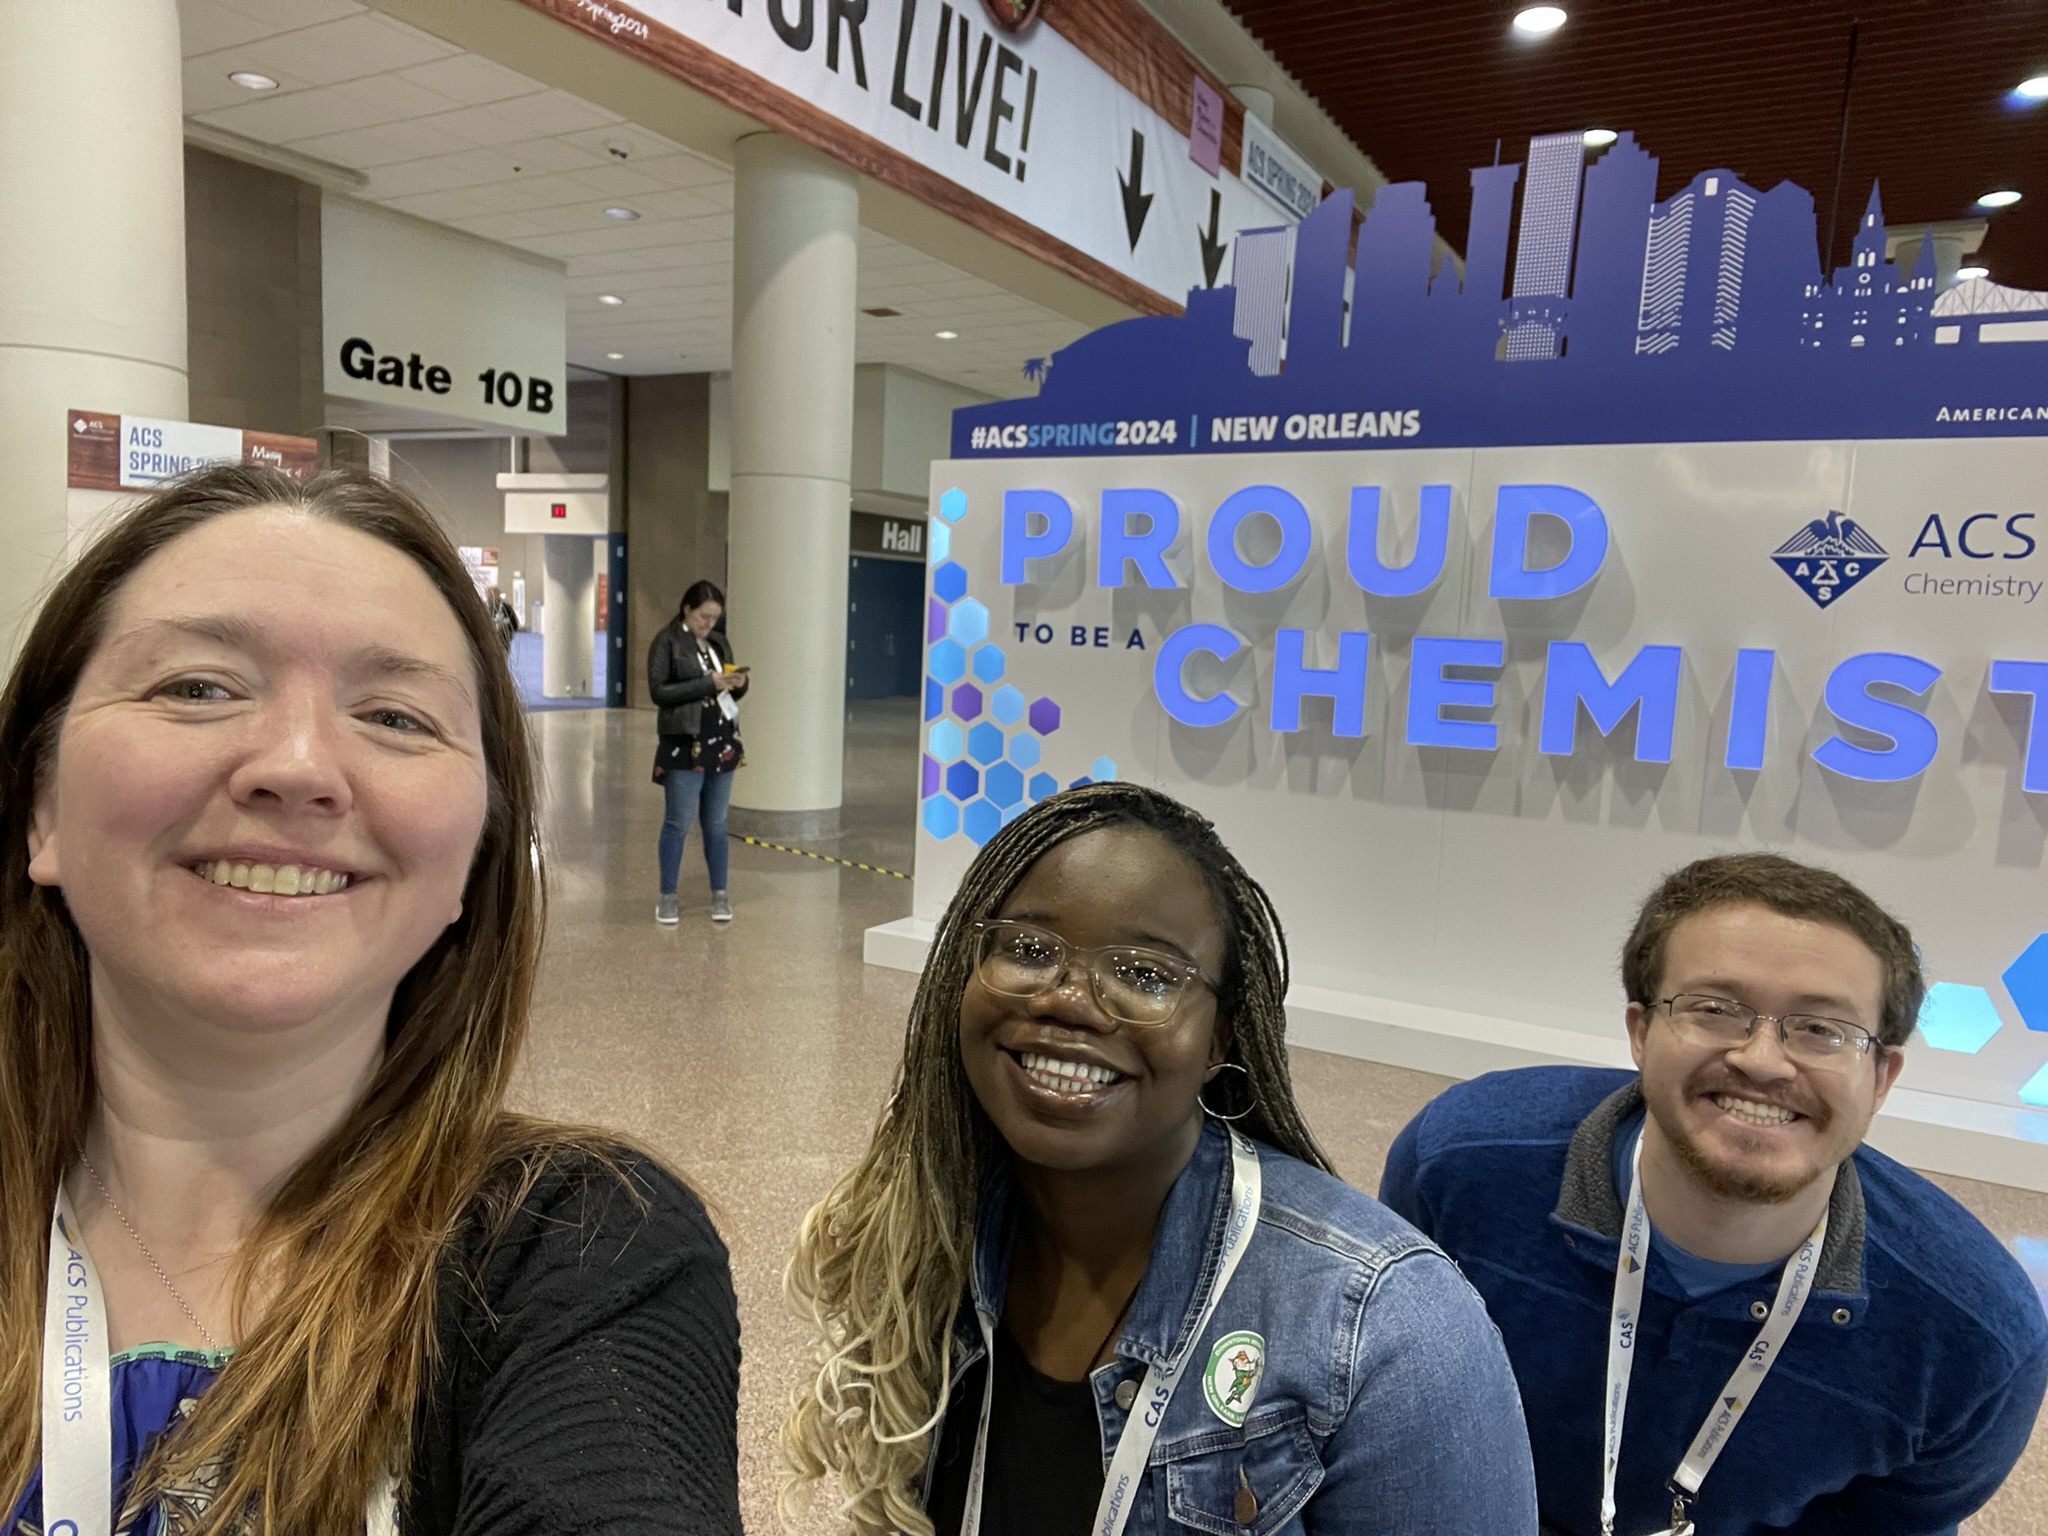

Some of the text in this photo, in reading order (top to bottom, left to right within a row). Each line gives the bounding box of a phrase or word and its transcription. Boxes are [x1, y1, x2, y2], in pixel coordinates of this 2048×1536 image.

[891, 0, 1037, 183] LIVE!
[340, 337, 554, 414] Gate 10B
[129, 426, 163, 448] ACS
[971, 410, 1421, 450] #ACSSPRING2024 NEW ORLEANS
[129, 451, 192, 474] SPRING
[882, 521, 922, 553] Hall
[1000, 484, 1609, 599] PROUD
[1908, 513, 2037, 560] ACS
[1904, 572, 2044, 604] Chemistry
[1015, 622, 1146, 650] TO BE A
[1628, 1233, 1640, 1255] ACS
[1800, 1241, 1814, 1264] ACS
[63, 1247, 90, 1422] ACS Publications
[1619, 1321, 1634, 1350] CAS
[1749, 1340, 1770, 1361] CAS
[1144, 1386, 1169, 1428] CAS
